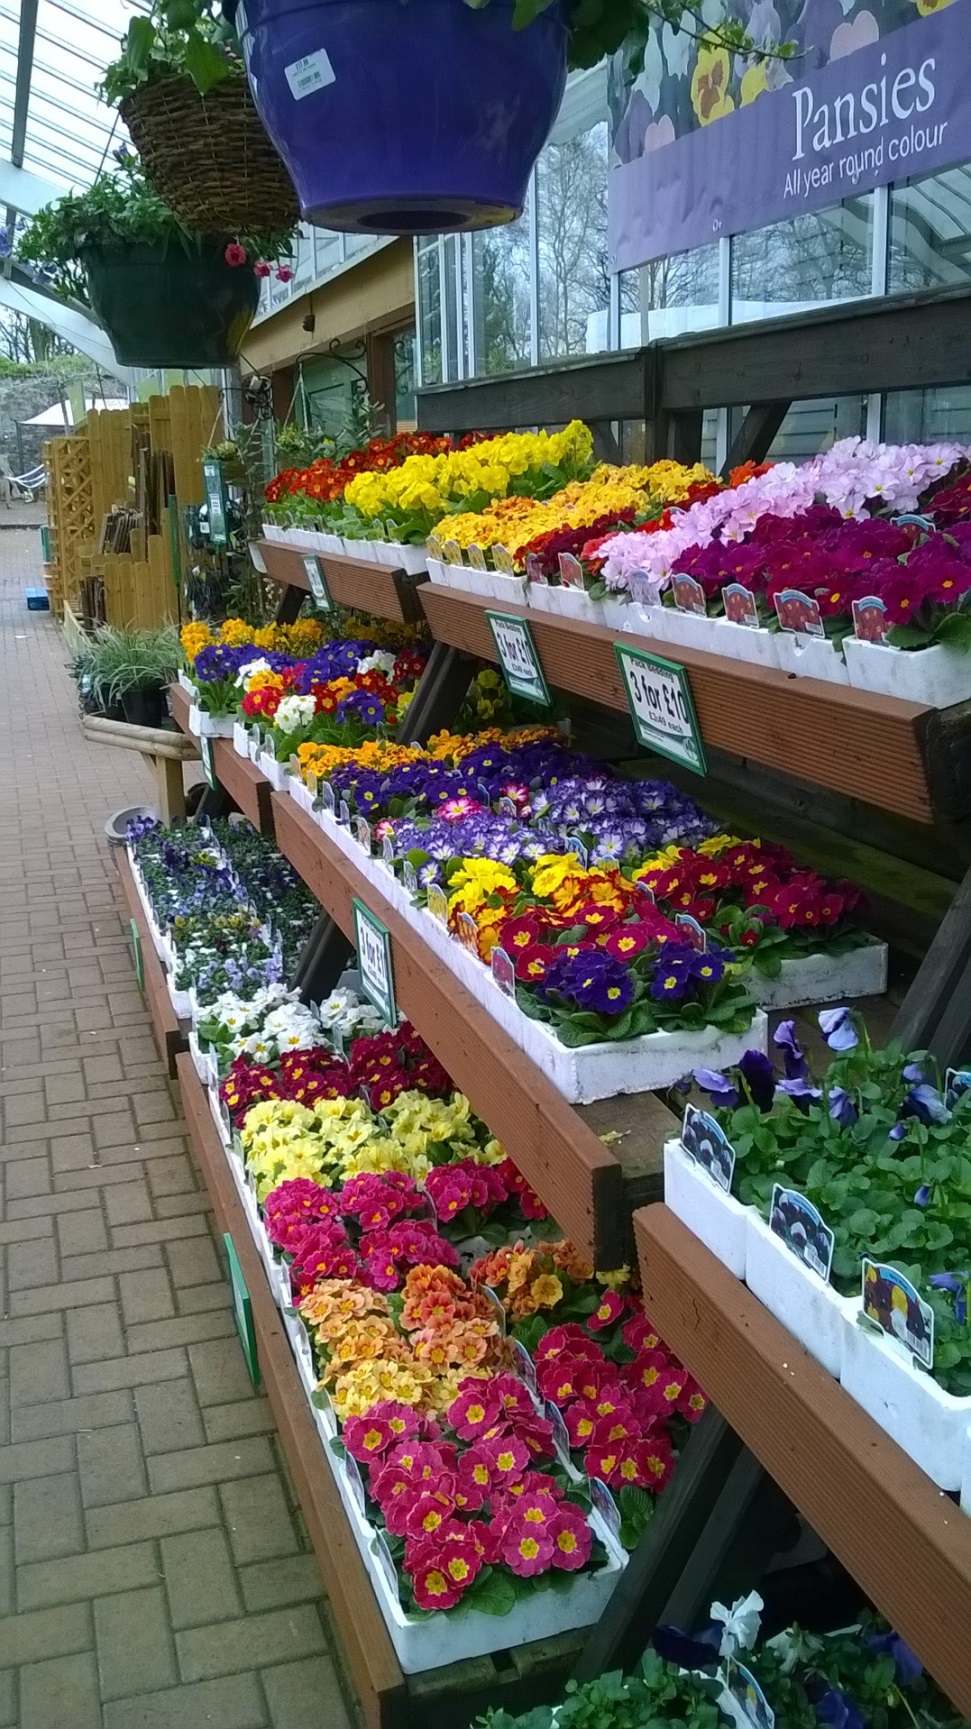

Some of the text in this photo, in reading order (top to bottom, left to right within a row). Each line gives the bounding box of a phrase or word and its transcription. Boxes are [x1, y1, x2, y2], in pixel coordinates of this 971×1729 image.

[792, 53, 936, 161] Pansies
[783, 120, 948, 199] All year round colour
[496, 632, 535, 667] 3 for £10
[630, 670, 690, 725] 3 for £10
